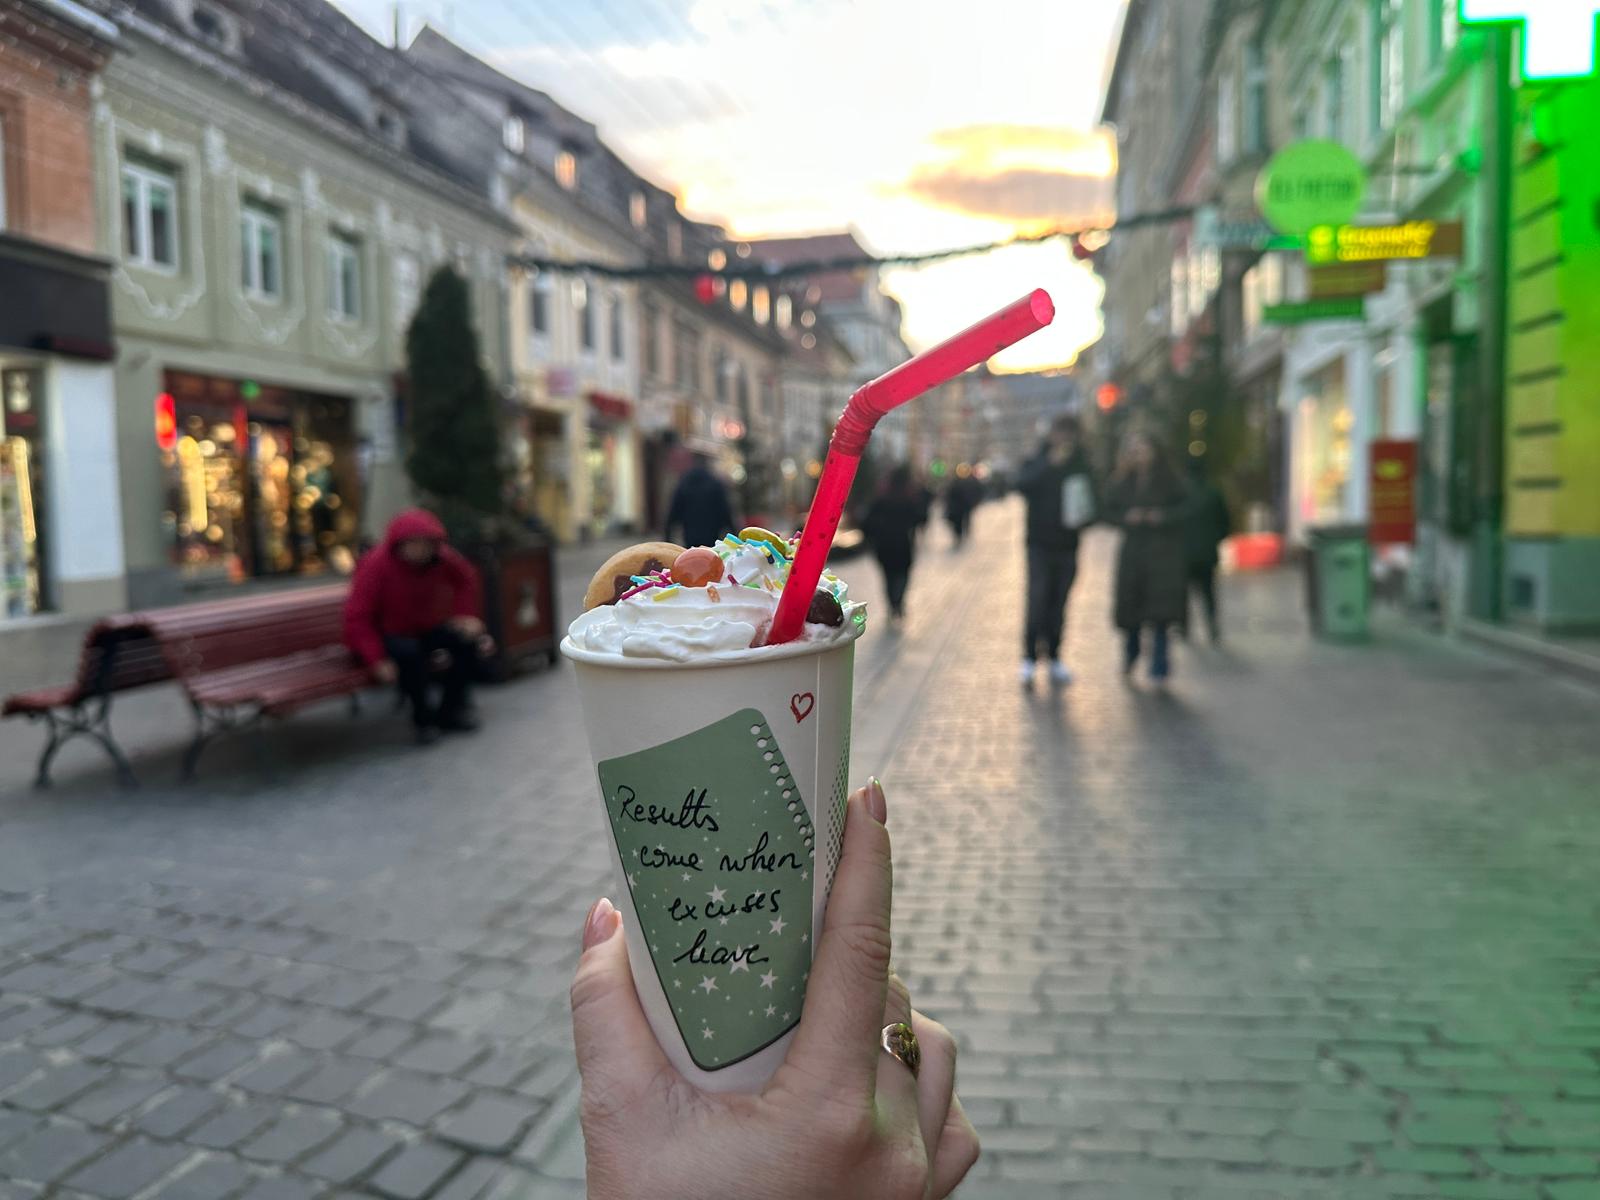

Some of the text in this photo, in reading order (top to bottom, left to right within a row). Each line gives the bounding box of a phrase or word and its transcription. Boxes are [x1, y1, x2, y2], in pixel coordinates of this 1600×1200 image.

[617, 785, 719, 832] Results
[640, 831, 802, 873] come when
[668, 888, 780, 921] excuses
[674, 929, 769, 965] leave
